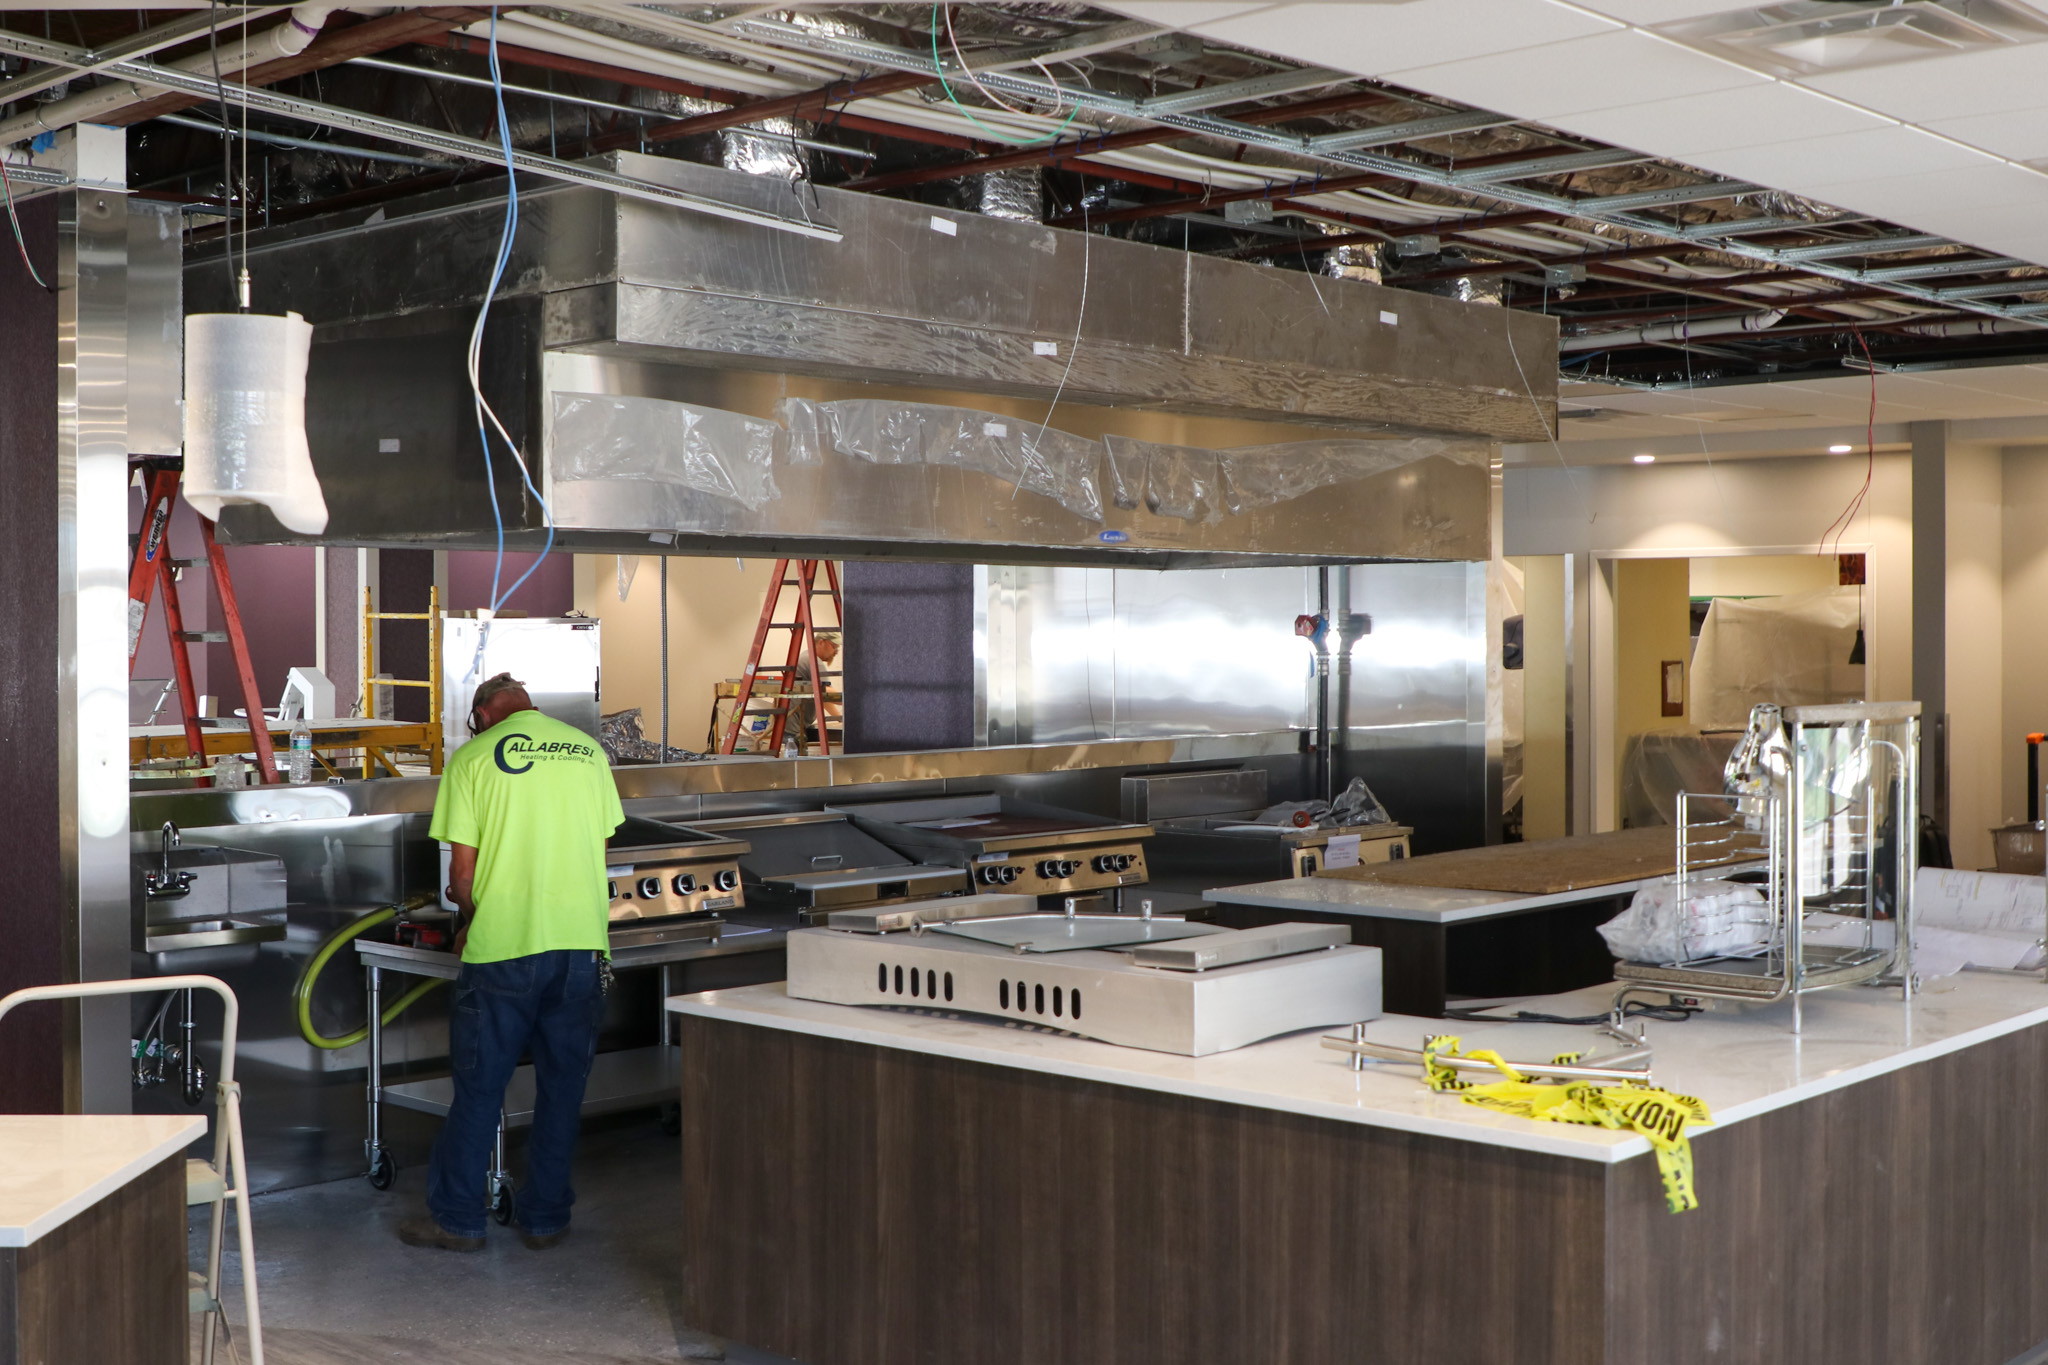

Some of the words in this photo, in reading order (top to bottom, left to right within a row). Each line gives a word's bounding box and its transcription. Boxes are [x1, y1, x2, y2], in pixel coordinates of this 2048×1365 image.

[149, 510, 165, 549] WERNER
[494, 733, 595, 774] CALLABRESI
[520, 753, 548, 761] Heating
[557, 754, 587, 763] Cooling,
